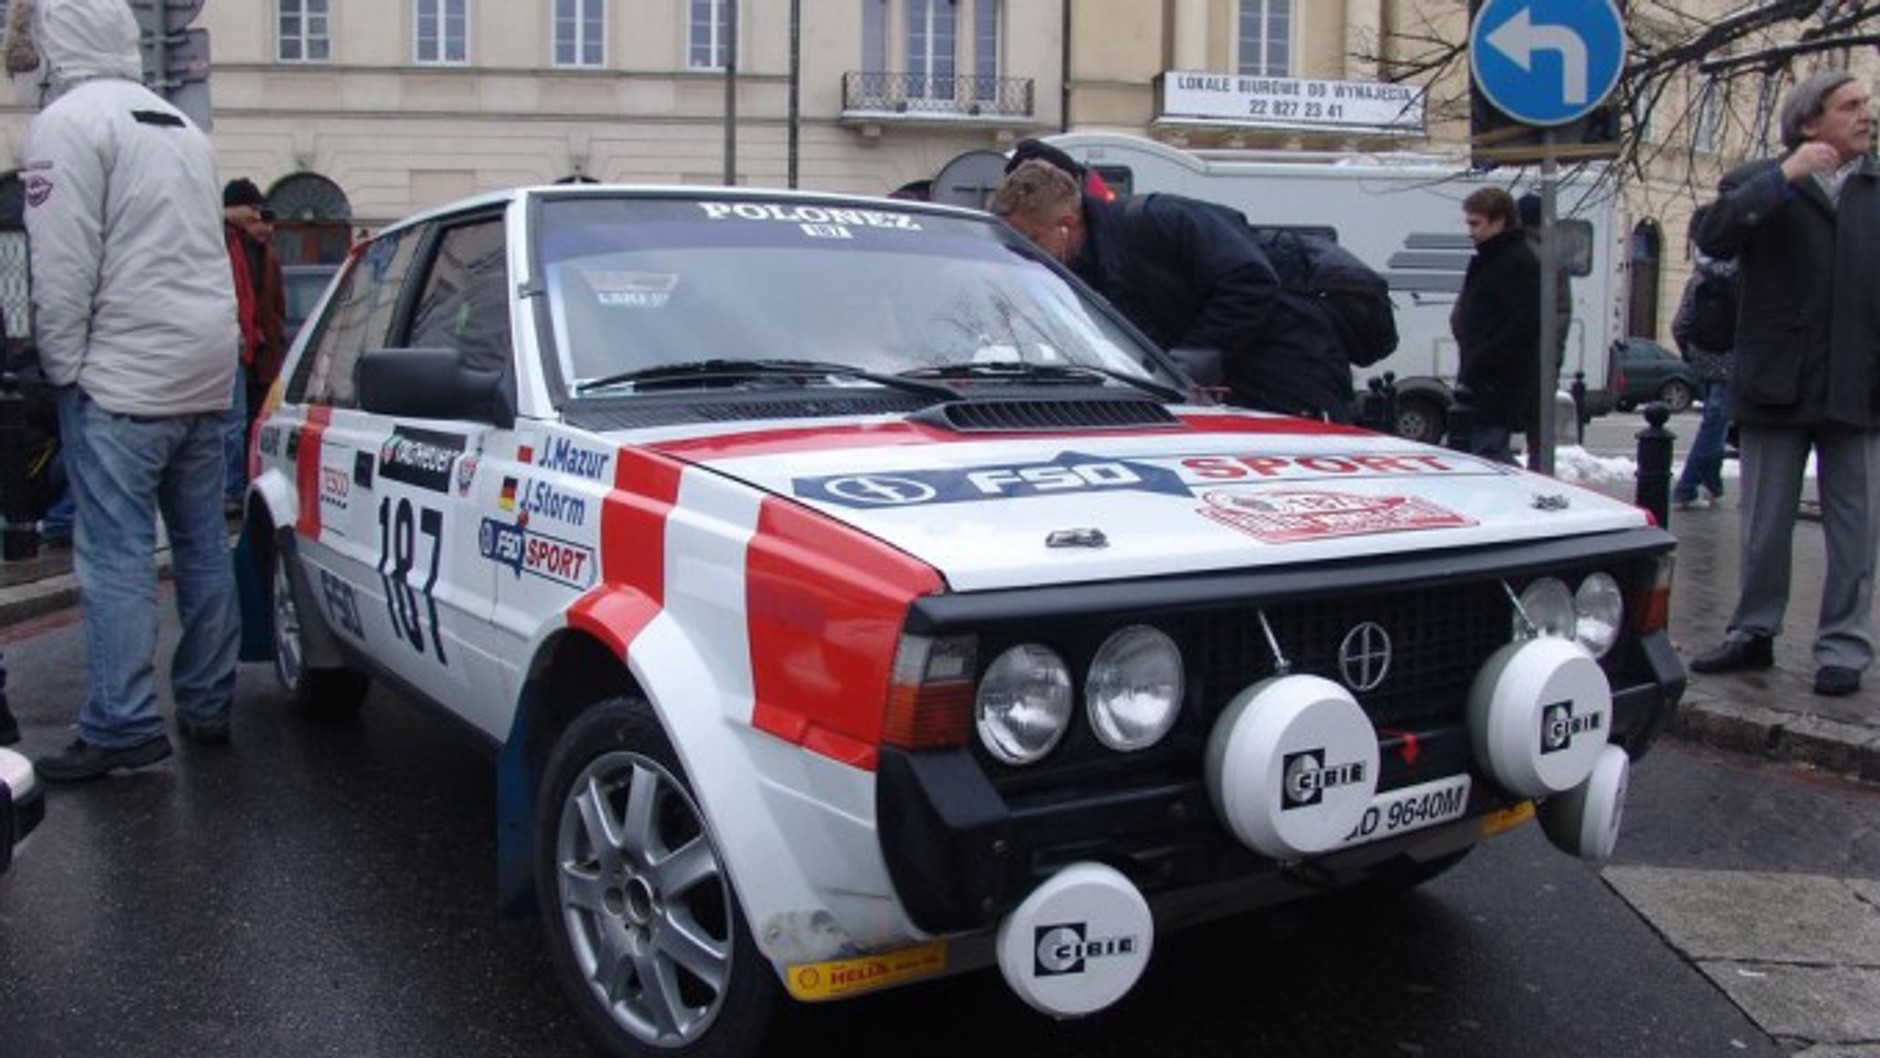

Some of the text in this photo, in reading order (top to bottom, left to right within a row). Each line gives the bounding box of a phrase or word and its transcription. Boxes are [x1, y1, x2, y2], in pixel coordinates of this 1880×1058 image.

[1177, 76, 1231, 93] LOKALE
[1238, 79, 1299, 95] BIUROWE
[1307, 82, 1327, 98] DO
[1249, 99, 1343, 119] 22 827 23 41
[698, 202, 922, 231] POLONEZ
[538, 434, 609, 480] J.Mazur
[1180, 455, 1451, 478] SPORT
[966, 462, 1142, 496] FSO
[519, 477, 585, 527] J.Storm
[524, 537, 587, 581] SPORT
[379, 495, 449, 668] 187
[1551, 711, 1602, 741] CIBIE
[1299, 763, 1364, 790] CIBIE
[1387, 782, 1466, 832] 9640M
[1055, 936, 1135, 961] CIBIE
[830, 962, 887, 986] HELIX
